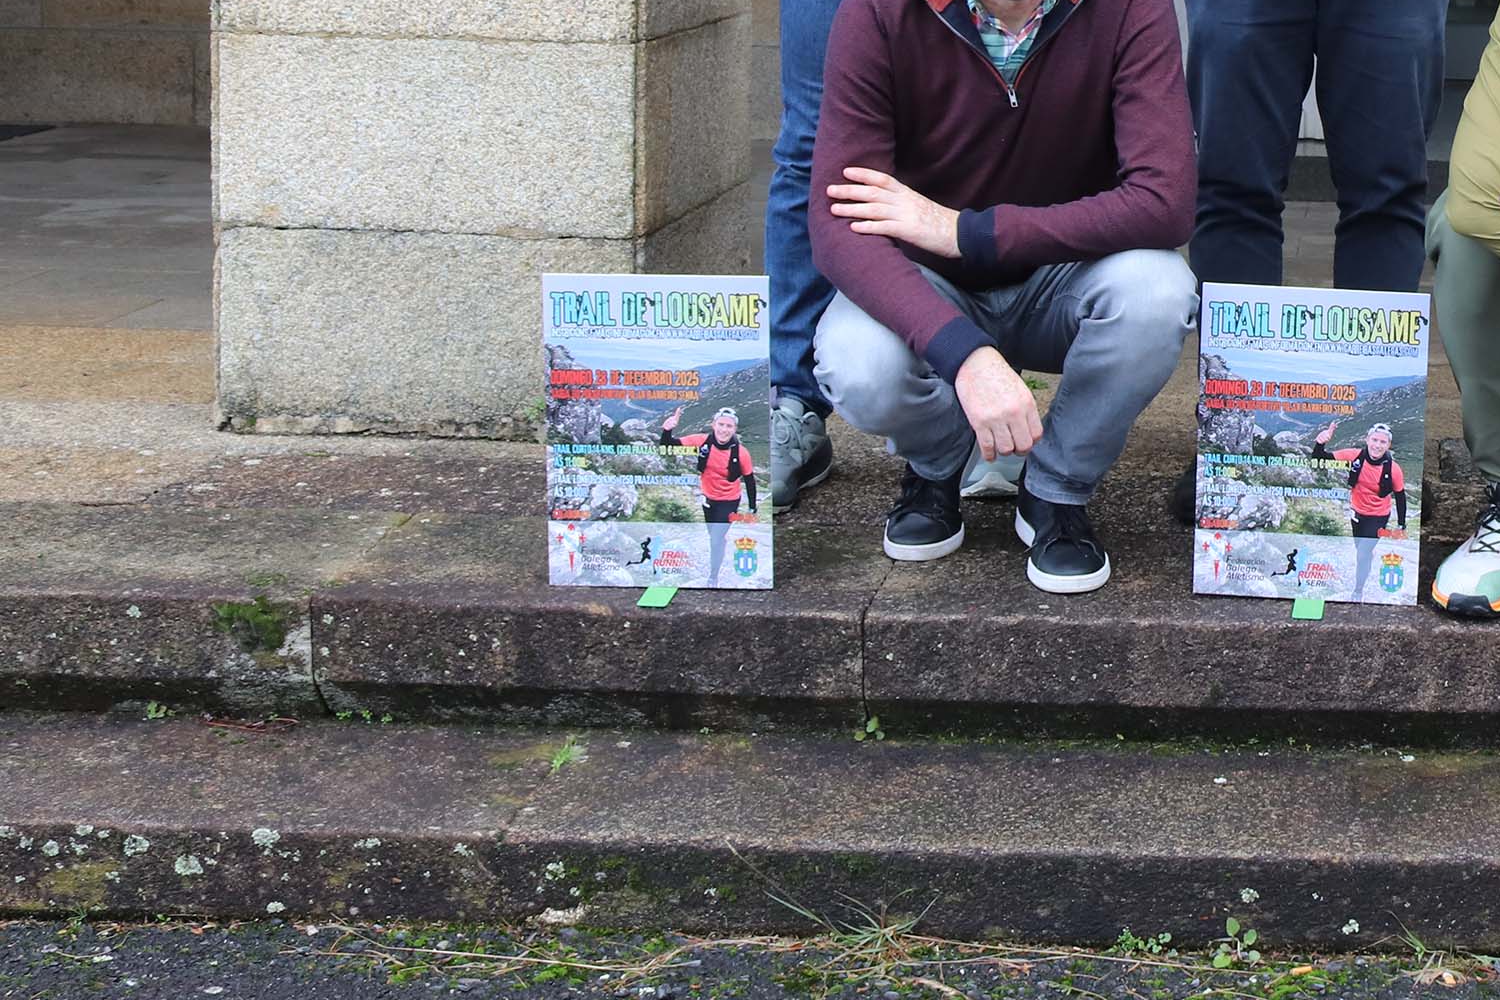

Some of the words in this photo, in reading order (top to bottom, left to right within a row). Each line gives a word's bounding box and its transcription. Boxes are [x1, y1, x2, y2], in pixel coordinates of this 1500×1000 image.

[549, 290, 616, 327] TRAIL
[621, 291, 648, 327] DE
[654, 291, 760, 329] LOUSAME
[1208, 299, 1276, 339] TRAIL
[1280, 303, 1308, 340] DE
[1313, 304, 1421, 346] LOUSAME
[674, 370, 700, 386] 2025
[1264, 381, 1276, 397] DE
[1278, 381, 1328, 400] DECEMBRO
[1330, 384, 1356, 401] 2025
[1204, 452, 1221, 463] TRAIL
[1203, 482, 1220, 493] TRAIL
[1225, 563, 1257, 574] Galega
[1306, 562, 1335, 572] TRAIL
[1225, 571, 1265, 582] Atletismo
